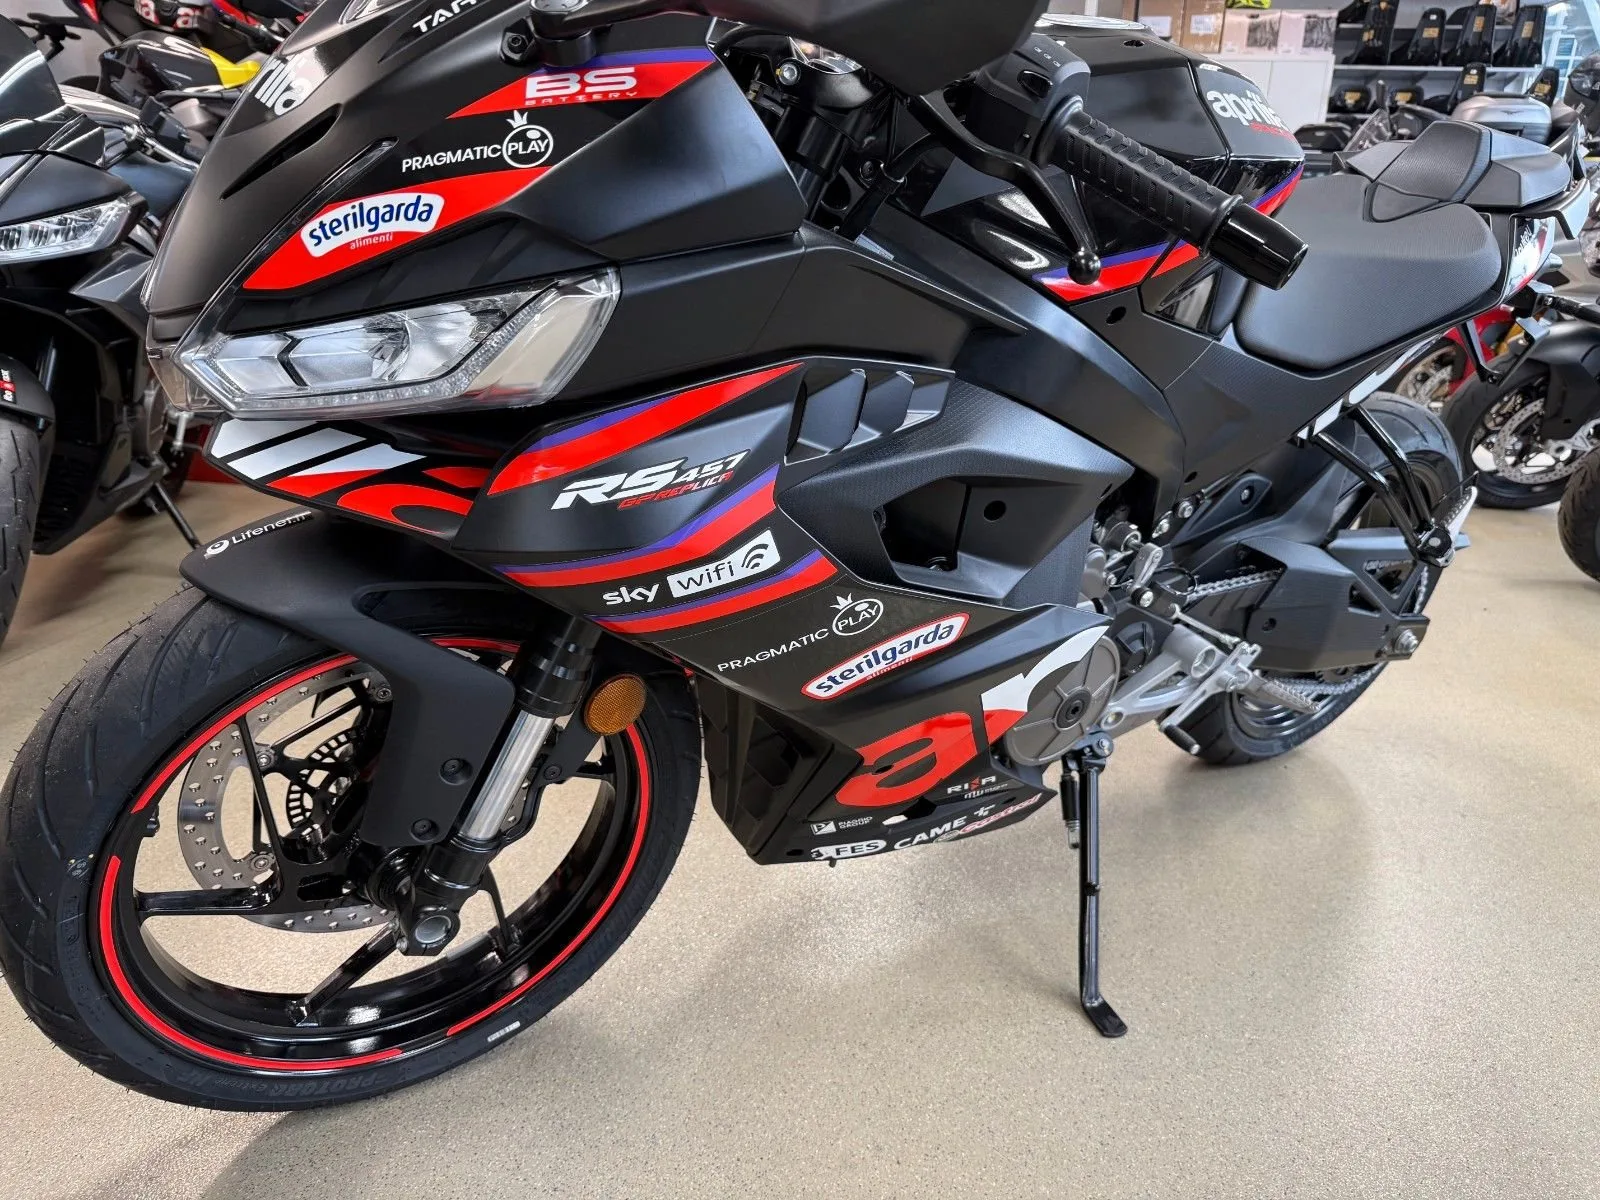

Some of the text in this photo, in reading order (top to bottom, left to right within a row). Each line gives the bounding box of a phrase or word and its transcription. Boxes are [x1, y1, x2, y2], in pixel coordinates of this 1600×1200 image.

[524, 91, 638, 106] BATTERY
[525, 67, 638, 98] BS
[402, 138, 549, 172] PRAGMATIC PLAY
[308, 195, 434, 247] sterilgarda
[350, 232, 394, 250] alimenti
[551, 450, 750, 510] RS 457
[602, 561, 735, 605] sky wifi
[717, 604, 879, 672] PRAGMATIC PLAY
[815, 623, 955, 693] sterilgarda
[893, 816, 968, 851] CAME
